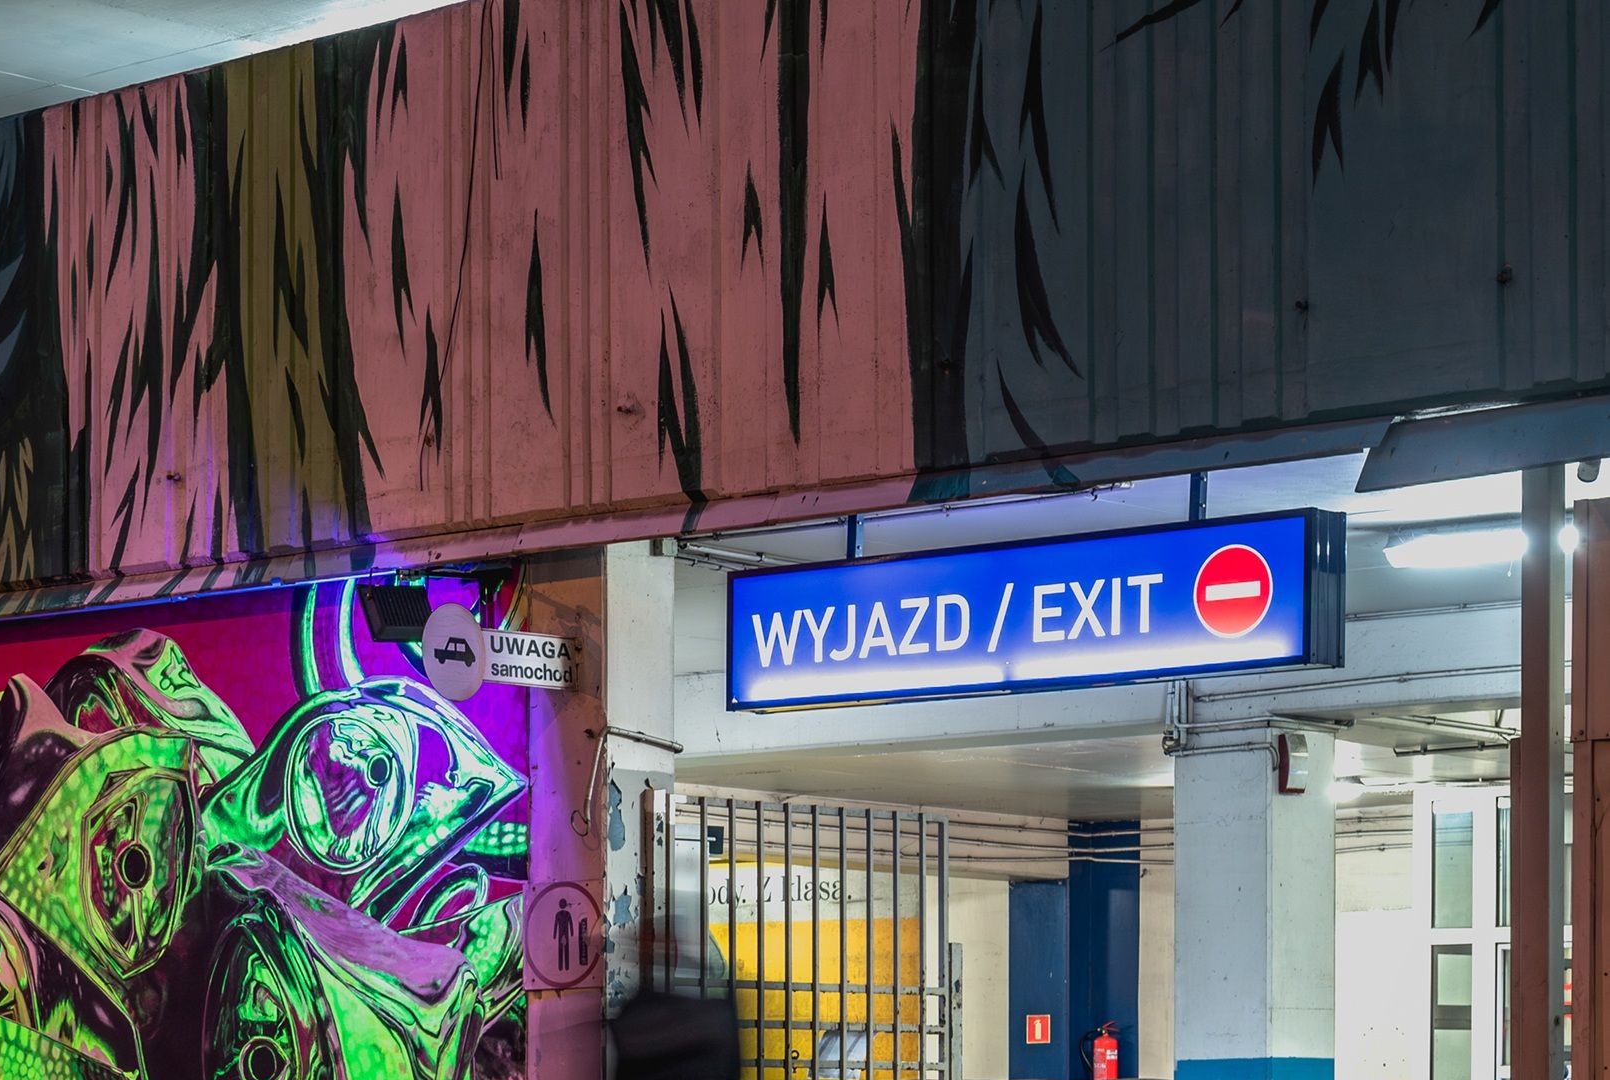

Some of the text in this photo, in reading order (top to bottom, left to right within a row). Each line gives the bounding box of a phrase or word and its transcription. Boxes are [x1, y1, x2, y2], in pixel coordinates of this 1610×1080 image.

[490, 635, 571, 661] UWAGA
[752, 593, 971, 668] WYJAZD
[1032, 572, 1163, 644] EXIT
